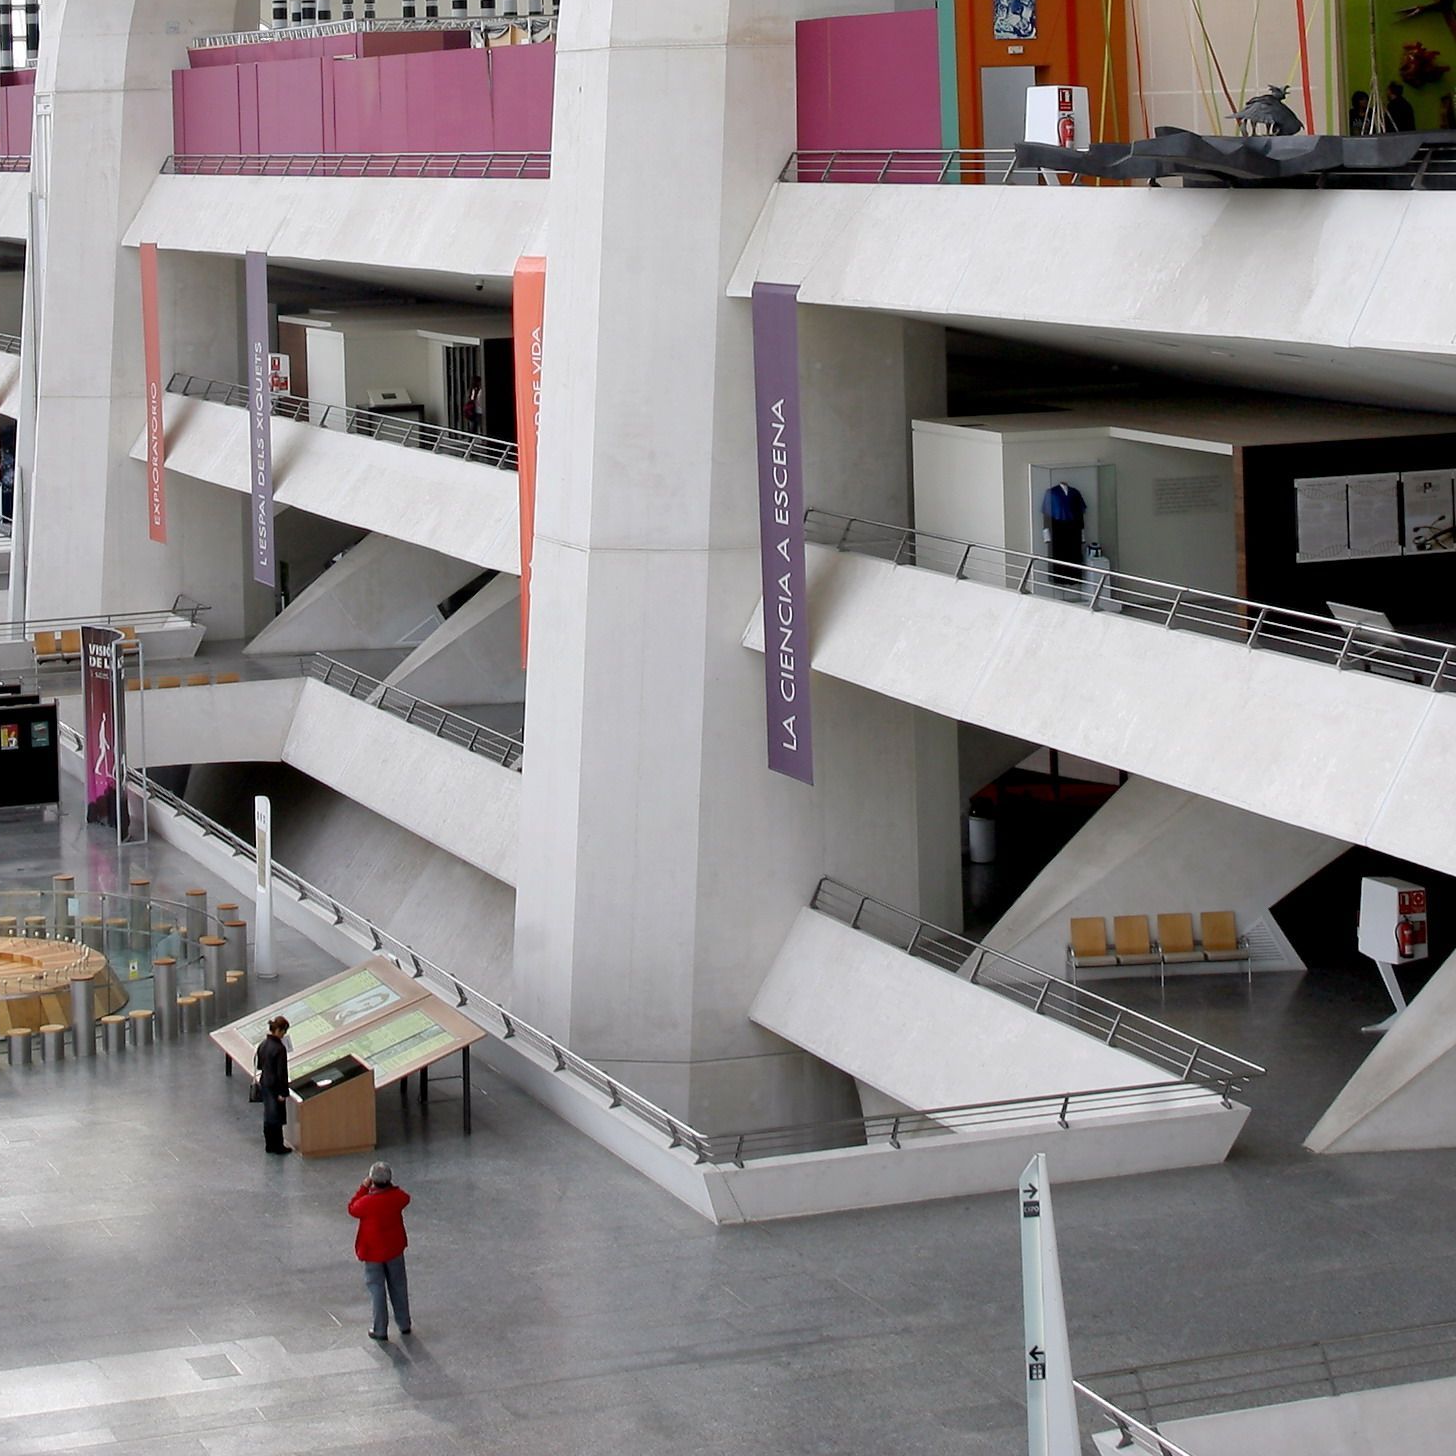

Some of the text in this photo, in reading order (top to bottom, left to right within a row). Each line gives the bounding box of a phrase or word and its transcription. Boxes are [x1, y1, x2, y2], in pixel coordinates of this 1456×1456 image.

[531, 326, 541, 375] VIDA
[149, 382, 161, 526] EXPLORATORIO
[255, 341, 267, 566] L'ESPAI DELS XIQUETS
[771, 398, 798, 751] LA CIENCIA A ESCENA
[89, 656, 103, 669] DE
